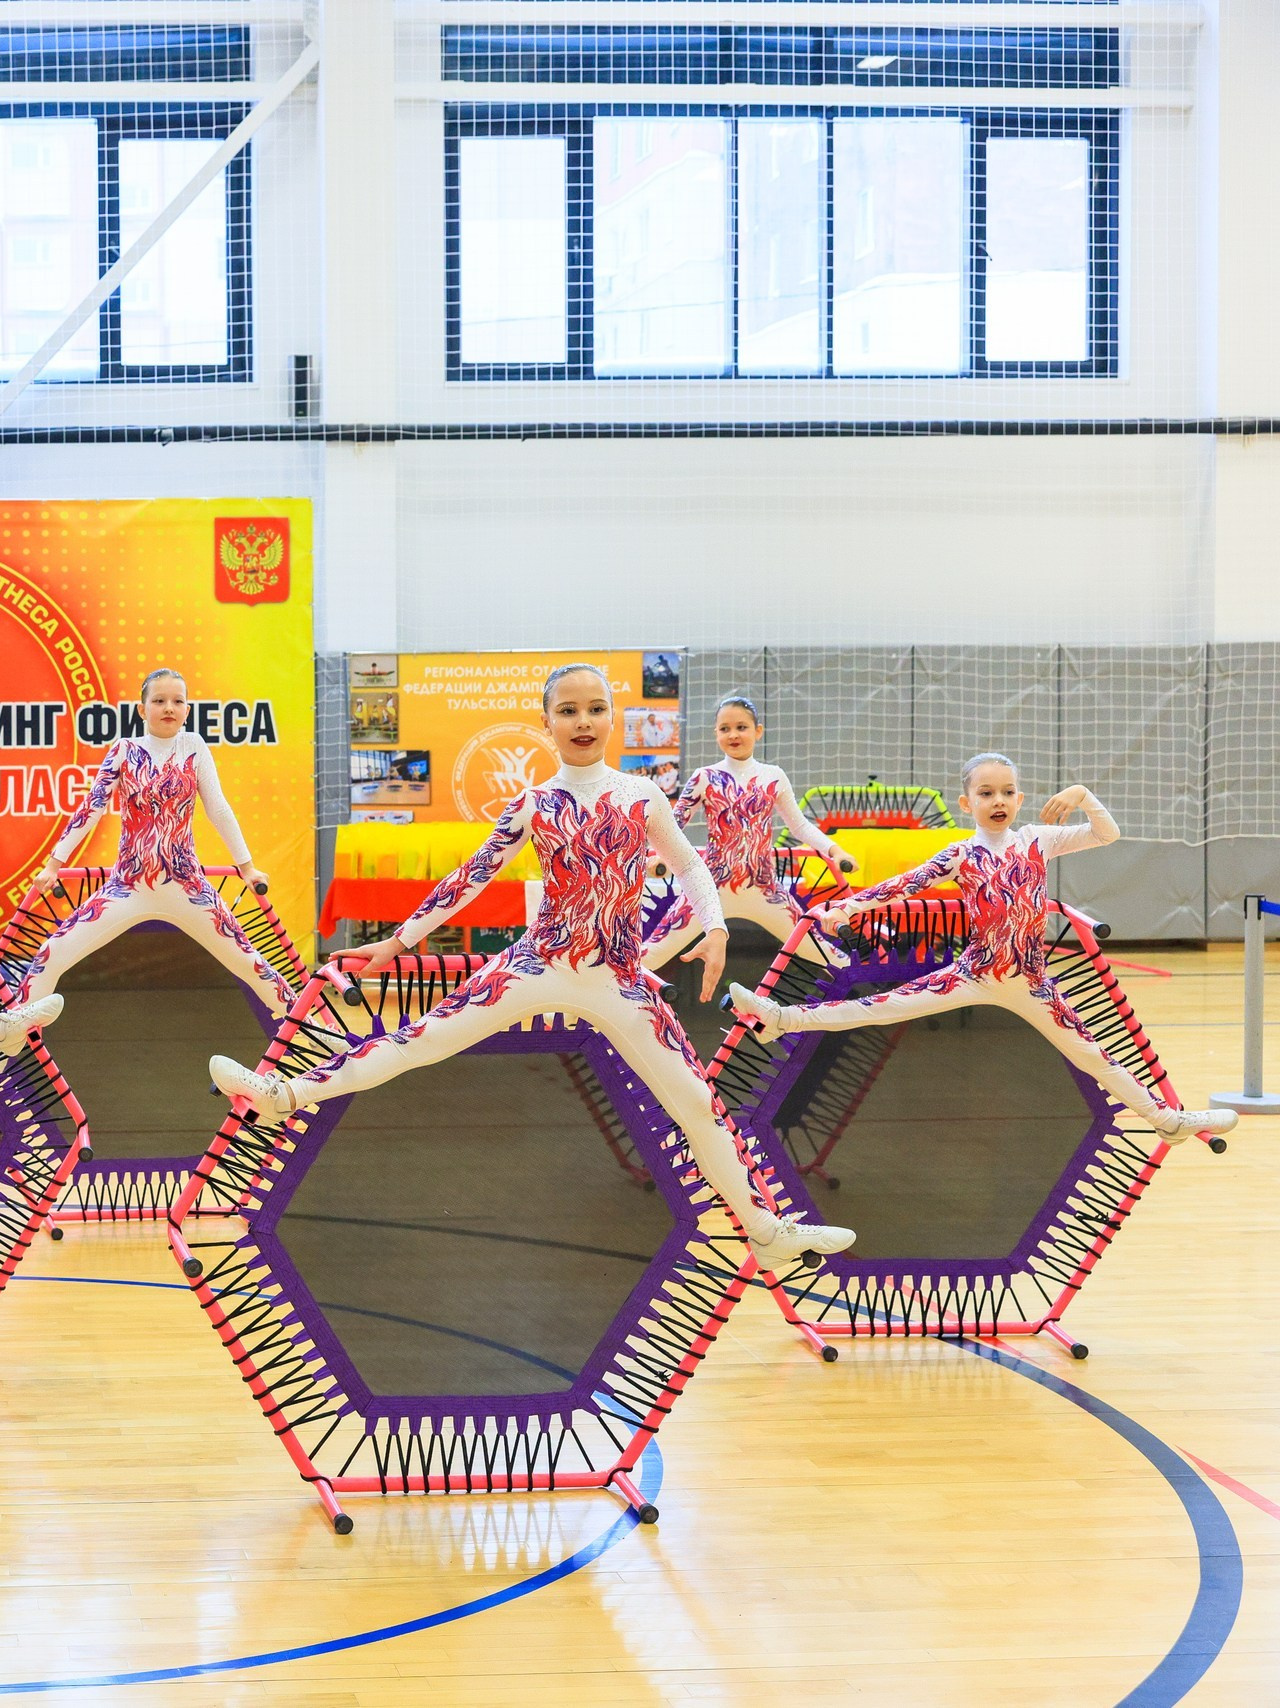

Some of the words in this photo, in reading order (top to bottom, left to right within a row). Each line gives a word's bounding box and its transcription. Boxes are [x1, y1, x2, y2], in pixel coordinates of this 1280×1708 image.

[54, 636, 97, 706] РОСС
[424, 664, 528, 678] РЕГИОНАЛЬНОЕ
[403, 681, 482, 695] ФЕДЕРАЦИИ
[485, 681, 544, 695] ДЖАМП
[447, 696, 518, 710] ТУЛЬСКОЙ
[78, 699, 278, 746] ФИЕСА
